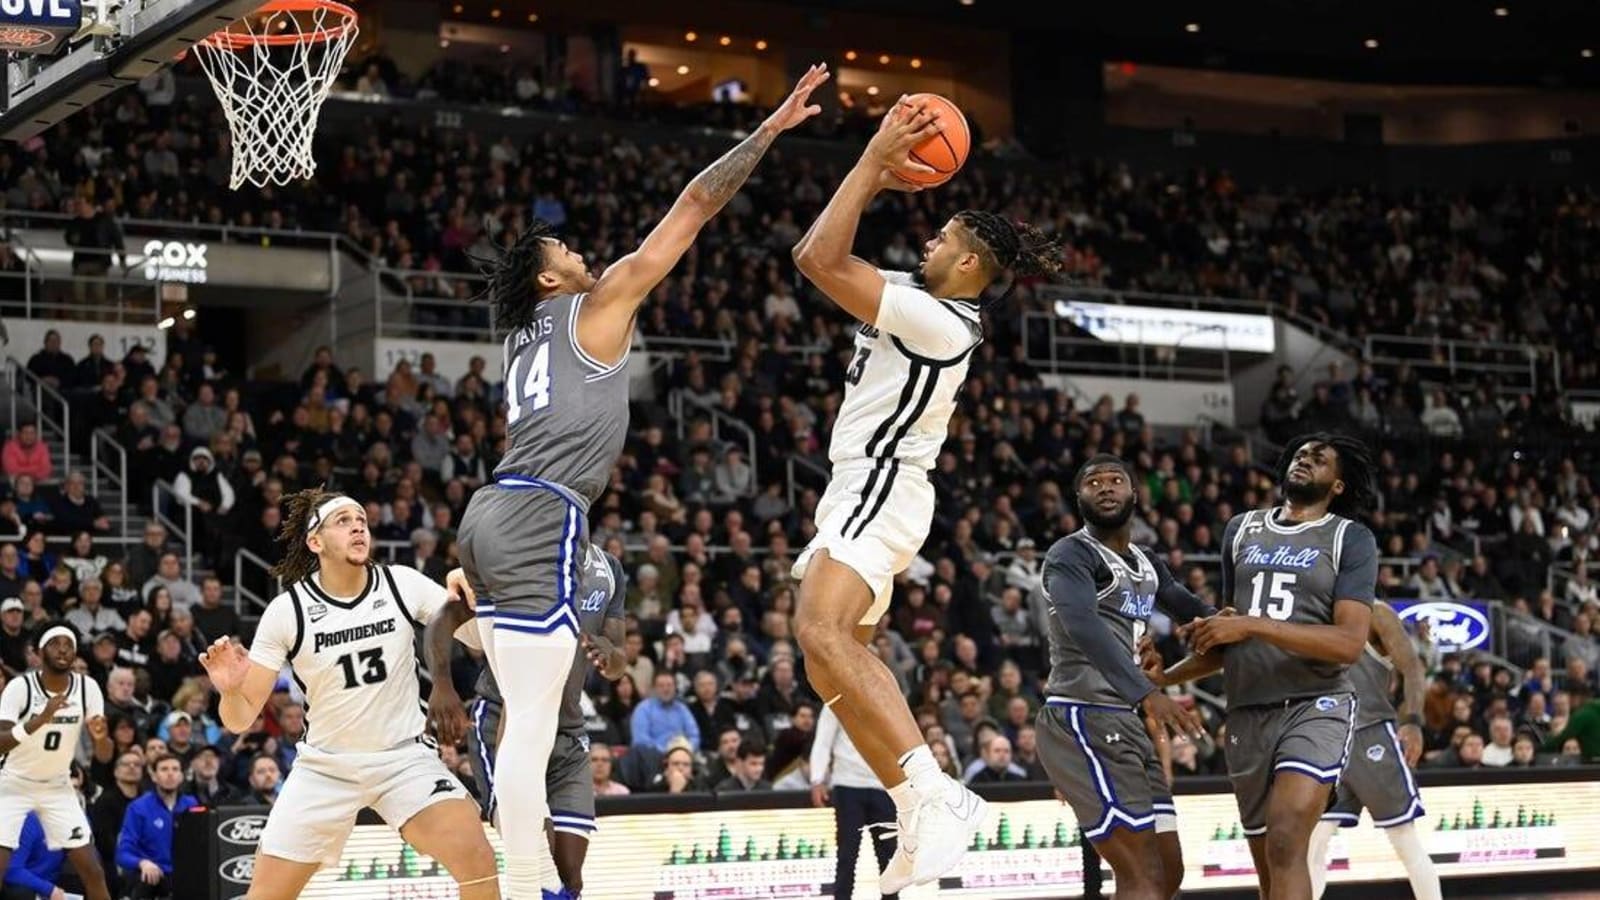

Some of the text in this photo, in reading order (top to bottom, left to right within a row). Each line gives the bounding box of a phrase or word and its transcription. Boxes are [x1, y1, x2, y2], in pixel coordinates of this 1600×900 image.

[144, 240, 207, 268] COX
[506, 341, 551, 425] 14
[1244, 544, 1320, 568] The Hall
[1247, 571, 1297, 621] 15
[314, 618, 396, 654] PROVIDENCE
[335, 646, 388, 690] 13
[43, 731, 61, 751] 0
